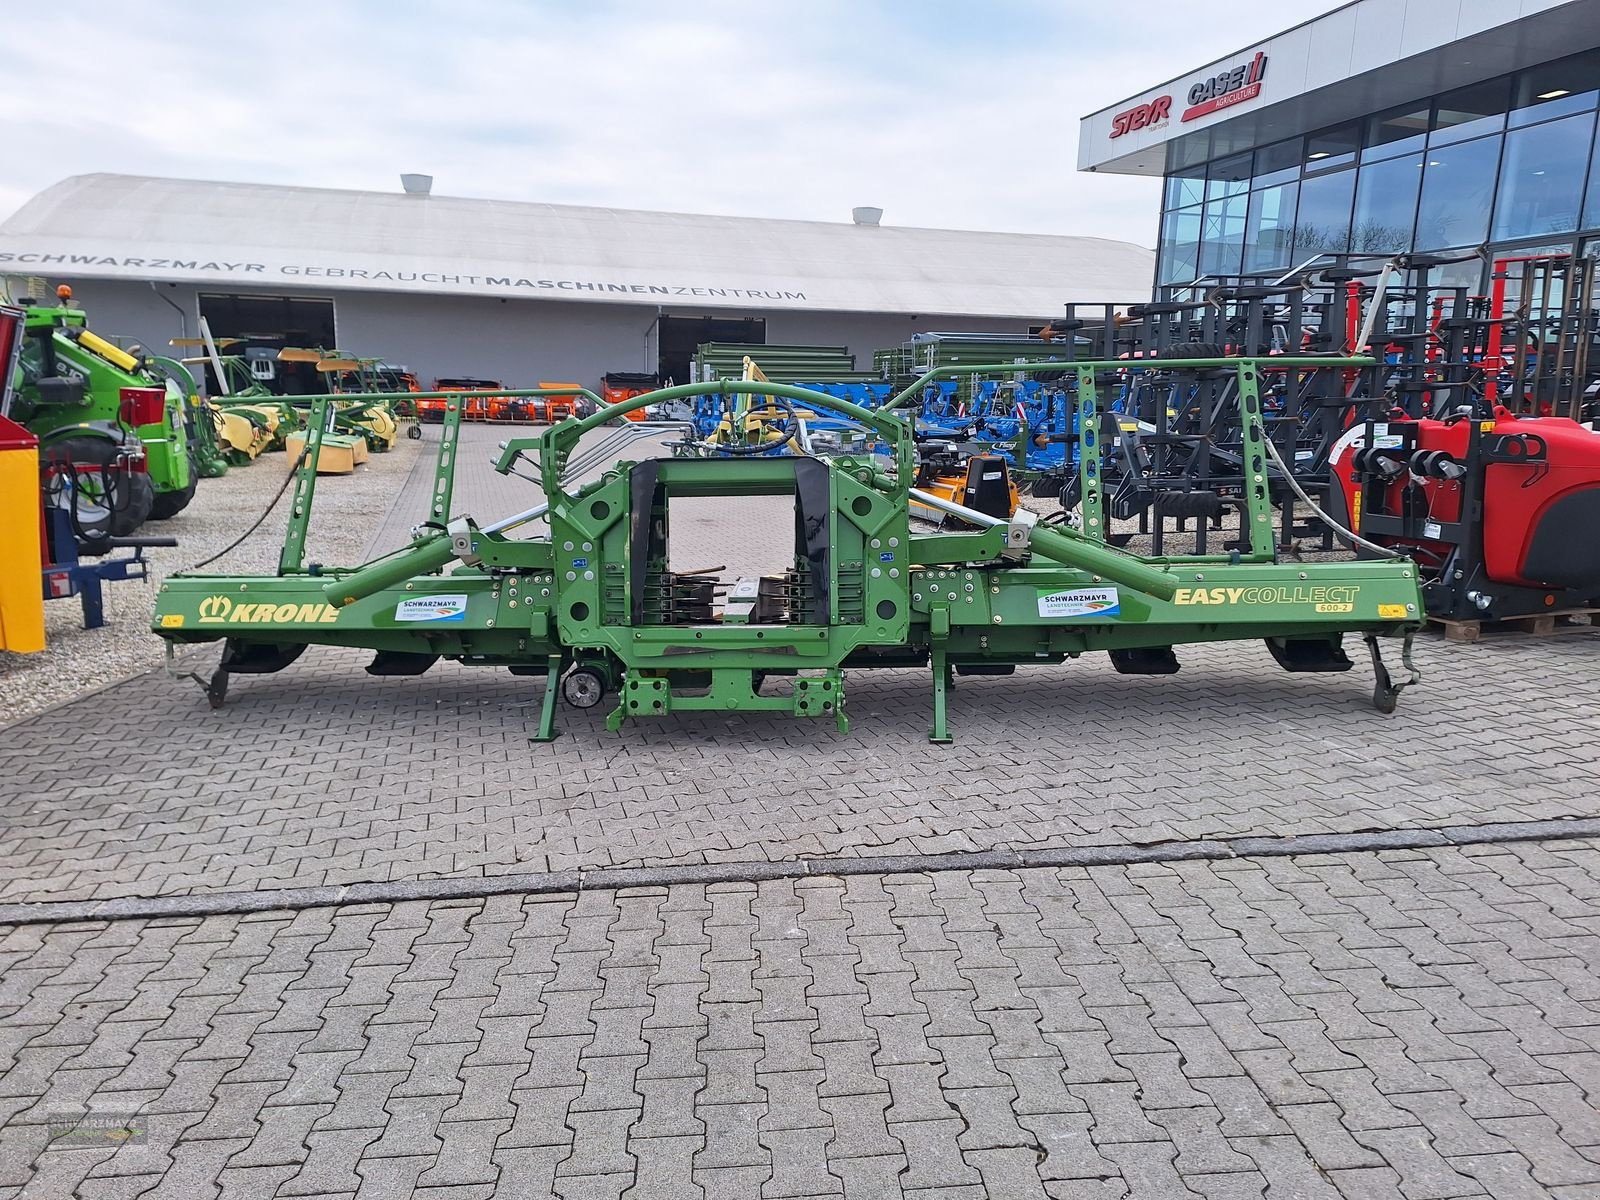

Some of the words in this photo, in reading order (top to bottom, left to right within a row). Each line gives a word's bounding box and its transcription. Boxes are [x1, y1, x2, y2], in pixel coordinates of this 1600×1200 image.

[1215, 87, 1257, 108] AGRICULTURE
[1109, 95, 1172, 139] STEYR
[0, 253, 266, 272] SCHWARZMAYR
[1044, 594, 1107, 602] SCHWARZMAYR
[1175, 586, 1360, 605] EASYCOLLECT
[229, 603, 342, 623] KRONE
[1320, 604, 1348, 612] 600-2
